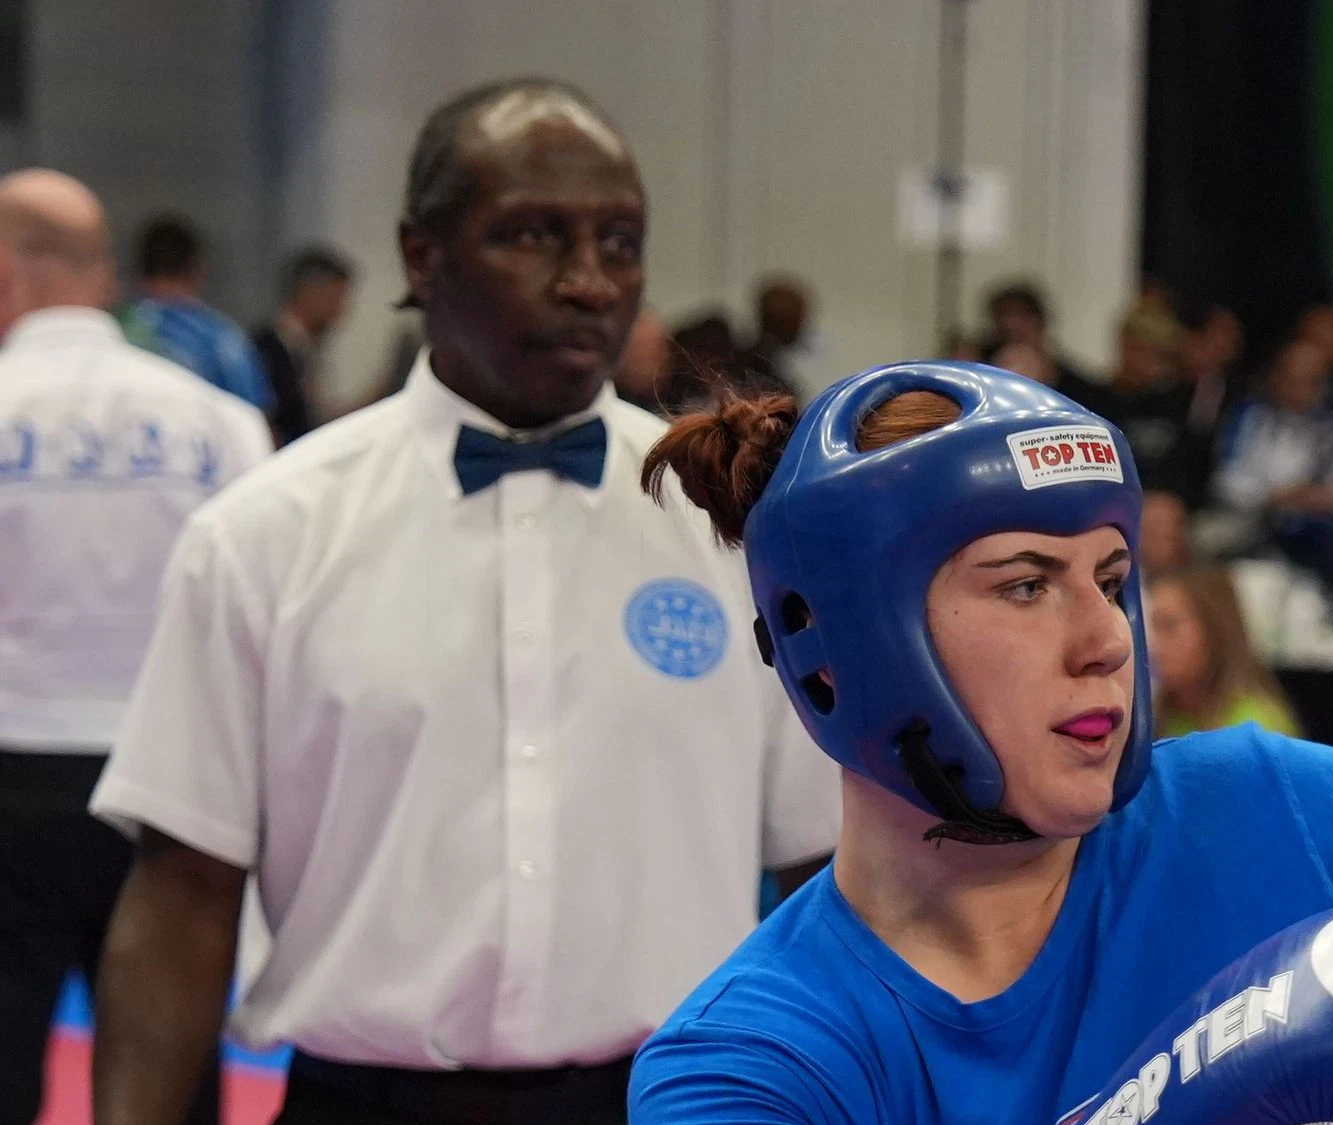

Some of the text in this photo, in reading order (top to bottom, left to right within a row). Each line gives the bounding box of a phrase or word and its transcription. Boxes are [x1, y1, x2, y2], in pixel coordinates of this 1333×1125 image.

[1022, 442, 1117, 470] TOP TEN
[1052, 467, 1072, 475] made
[1173, 970, 1294, 1084] TEN
